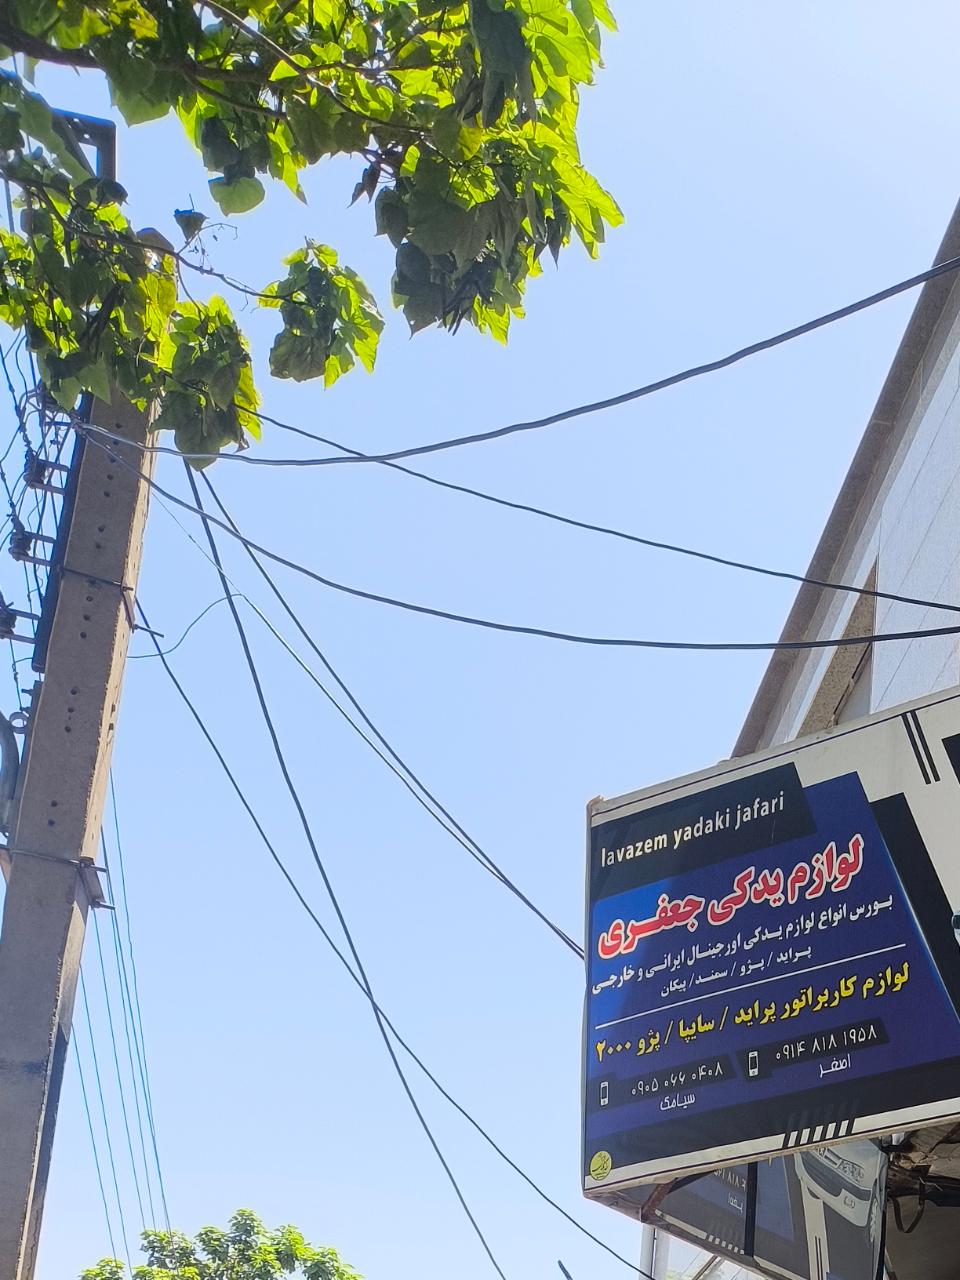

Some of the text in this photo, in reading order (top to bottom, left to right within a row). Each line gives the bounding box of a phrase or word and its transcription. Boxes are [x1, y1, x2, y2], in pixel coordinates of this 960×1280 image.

[601, 791, 785, 867] lavazem yadaki jafari
[599, 834, 864, 959] لوازم یدکی جعفری
[591, 894, 893, 996] بورس انواع لوازم یدکی اورجینال ایرانی و خارجی
[776, 945, 812, 964] پراید
[739, 957, 765, 977] پژو
[862, 961, 909, 999] لوازم
[734, 999, 776, 1026] پراید
[780, 975, 858, 1020] کاربراتور
[636, 1029, 661, 1056] پژو
[678, 1014, 716, 1044] سایپا
[776, 1024, 877, 1061] ۰۹۱۴ ۸۱۸ ۱۹۵۸
[595, 1039, 631, 1063] ۲۰۰۰
[631, 1061, 723, 1096] ۰۹۰۵ ۰۶۶ ۰۴۰۸
[660, 1092, 696, 1111] سیامک
